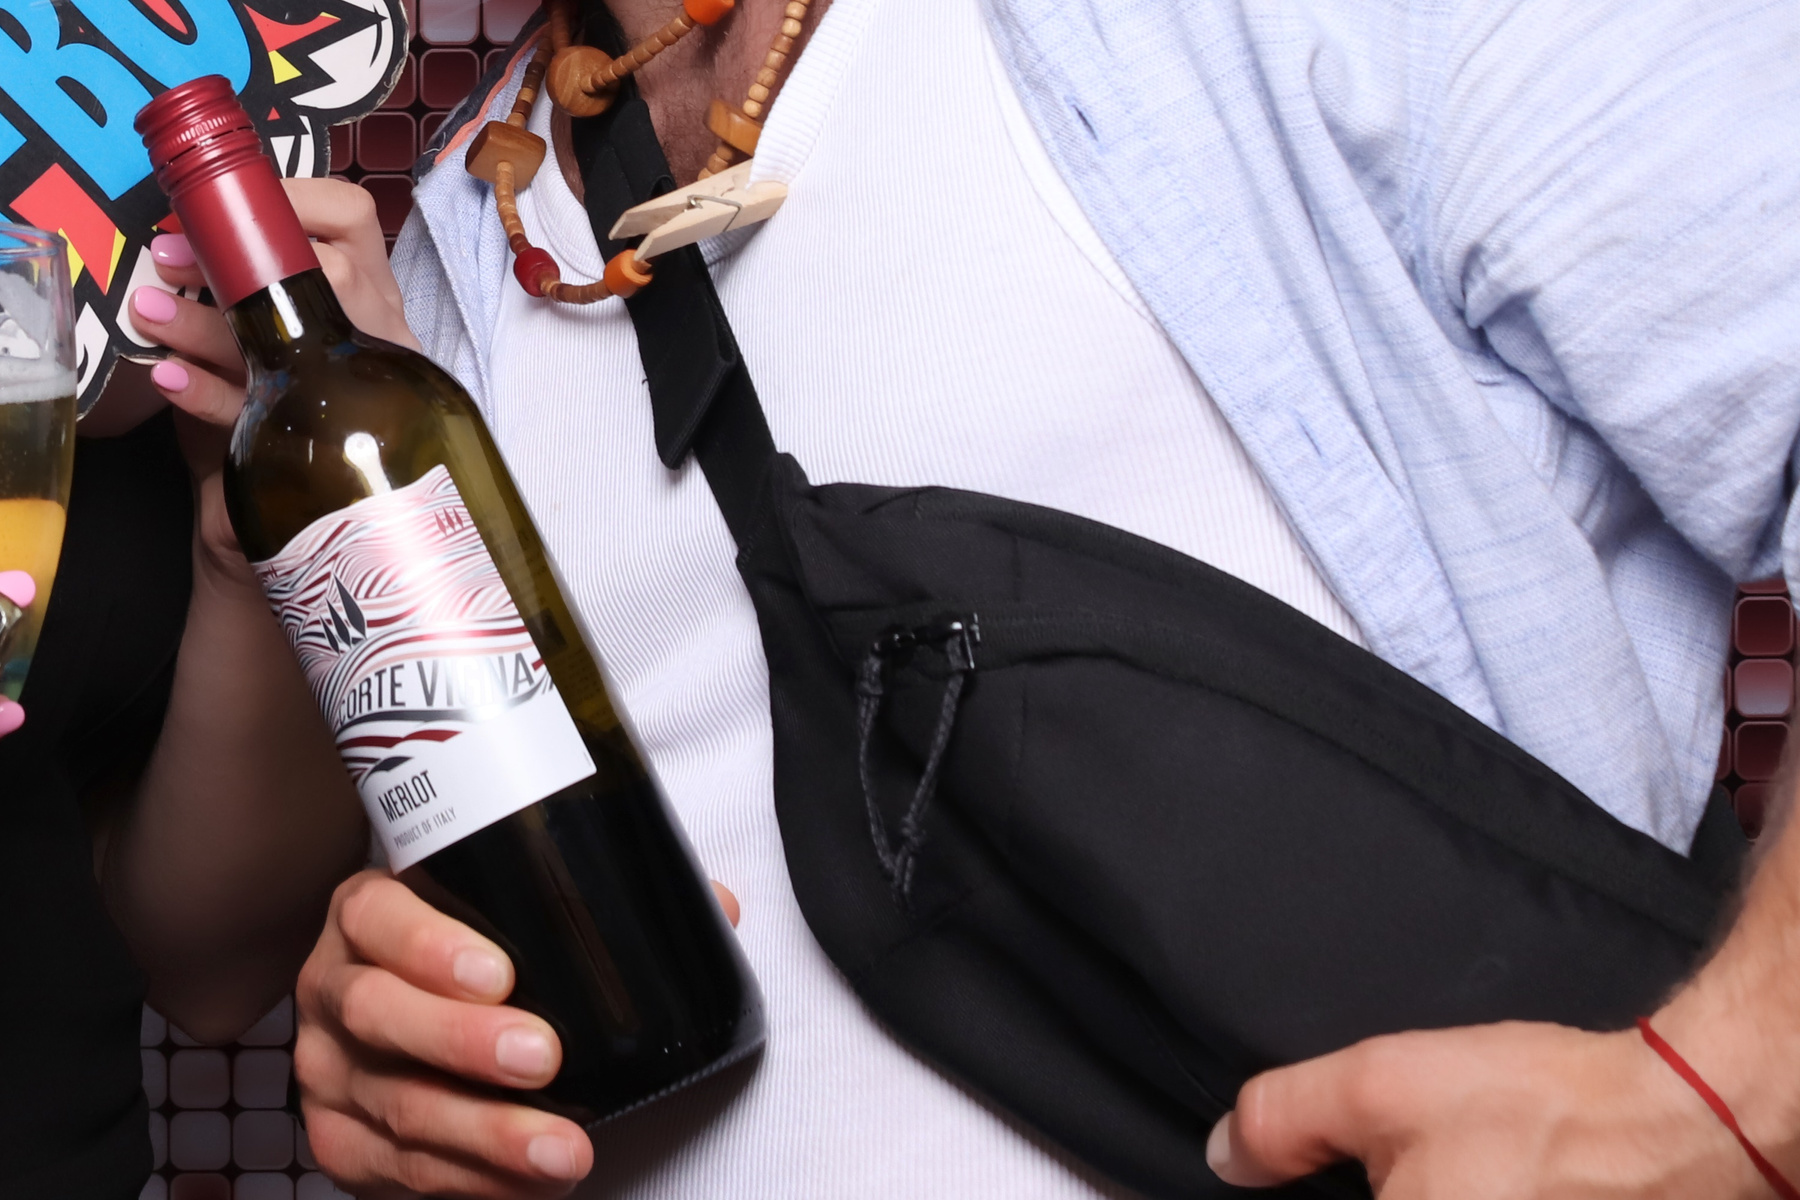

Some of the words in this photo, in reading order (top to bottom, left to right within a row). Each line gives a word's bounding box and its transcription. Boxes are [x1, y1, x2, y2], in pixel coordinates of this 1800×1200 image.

[338, 664, 406, 726] CORTE
[378, 770, 437, 823] MERLOT
[393, 824, 423, 850] PRODUCT
[421, 819, 433, 834] OF
[433, 807, 457, 829] ITALY
